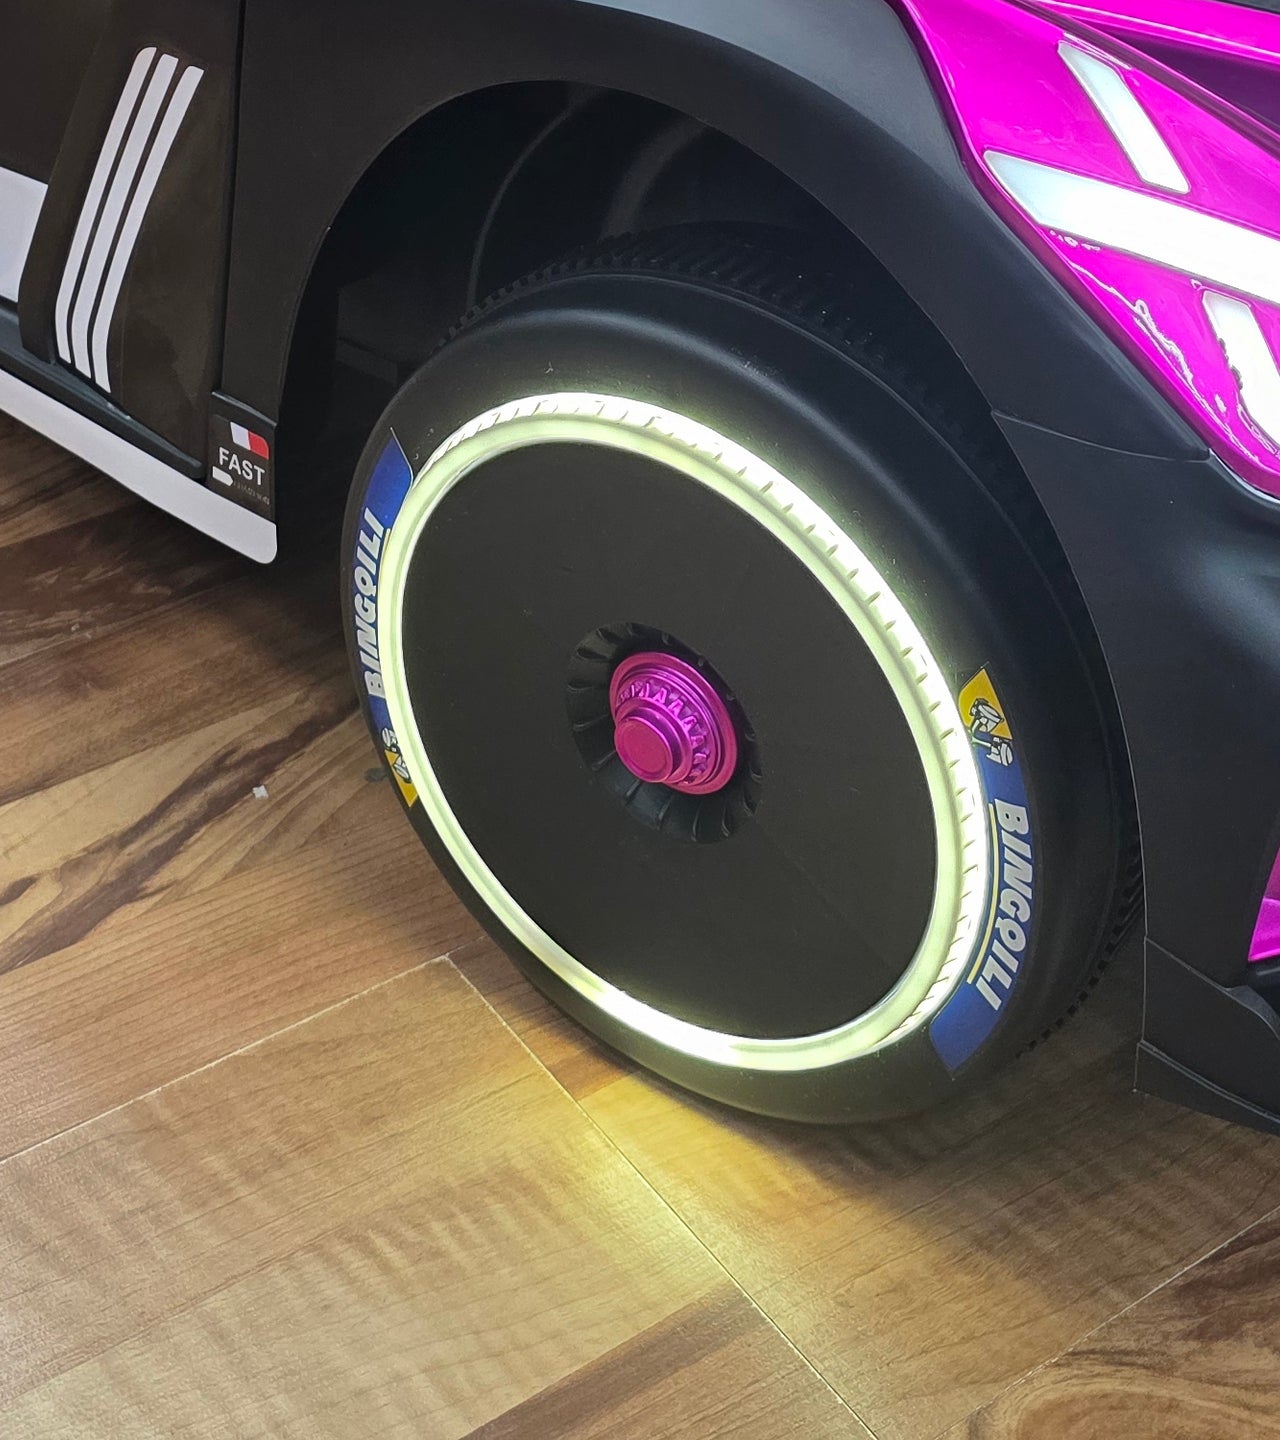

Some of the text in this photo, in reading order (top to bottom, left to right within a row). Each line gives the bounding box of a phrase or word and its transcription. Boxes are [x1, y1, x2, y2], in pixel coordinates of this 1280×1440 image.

[218, 446, 266, 486] FAST
[353, 507, 386, 700] BINGQILI
[975, 798, 1033, 1011] BINGQILI
